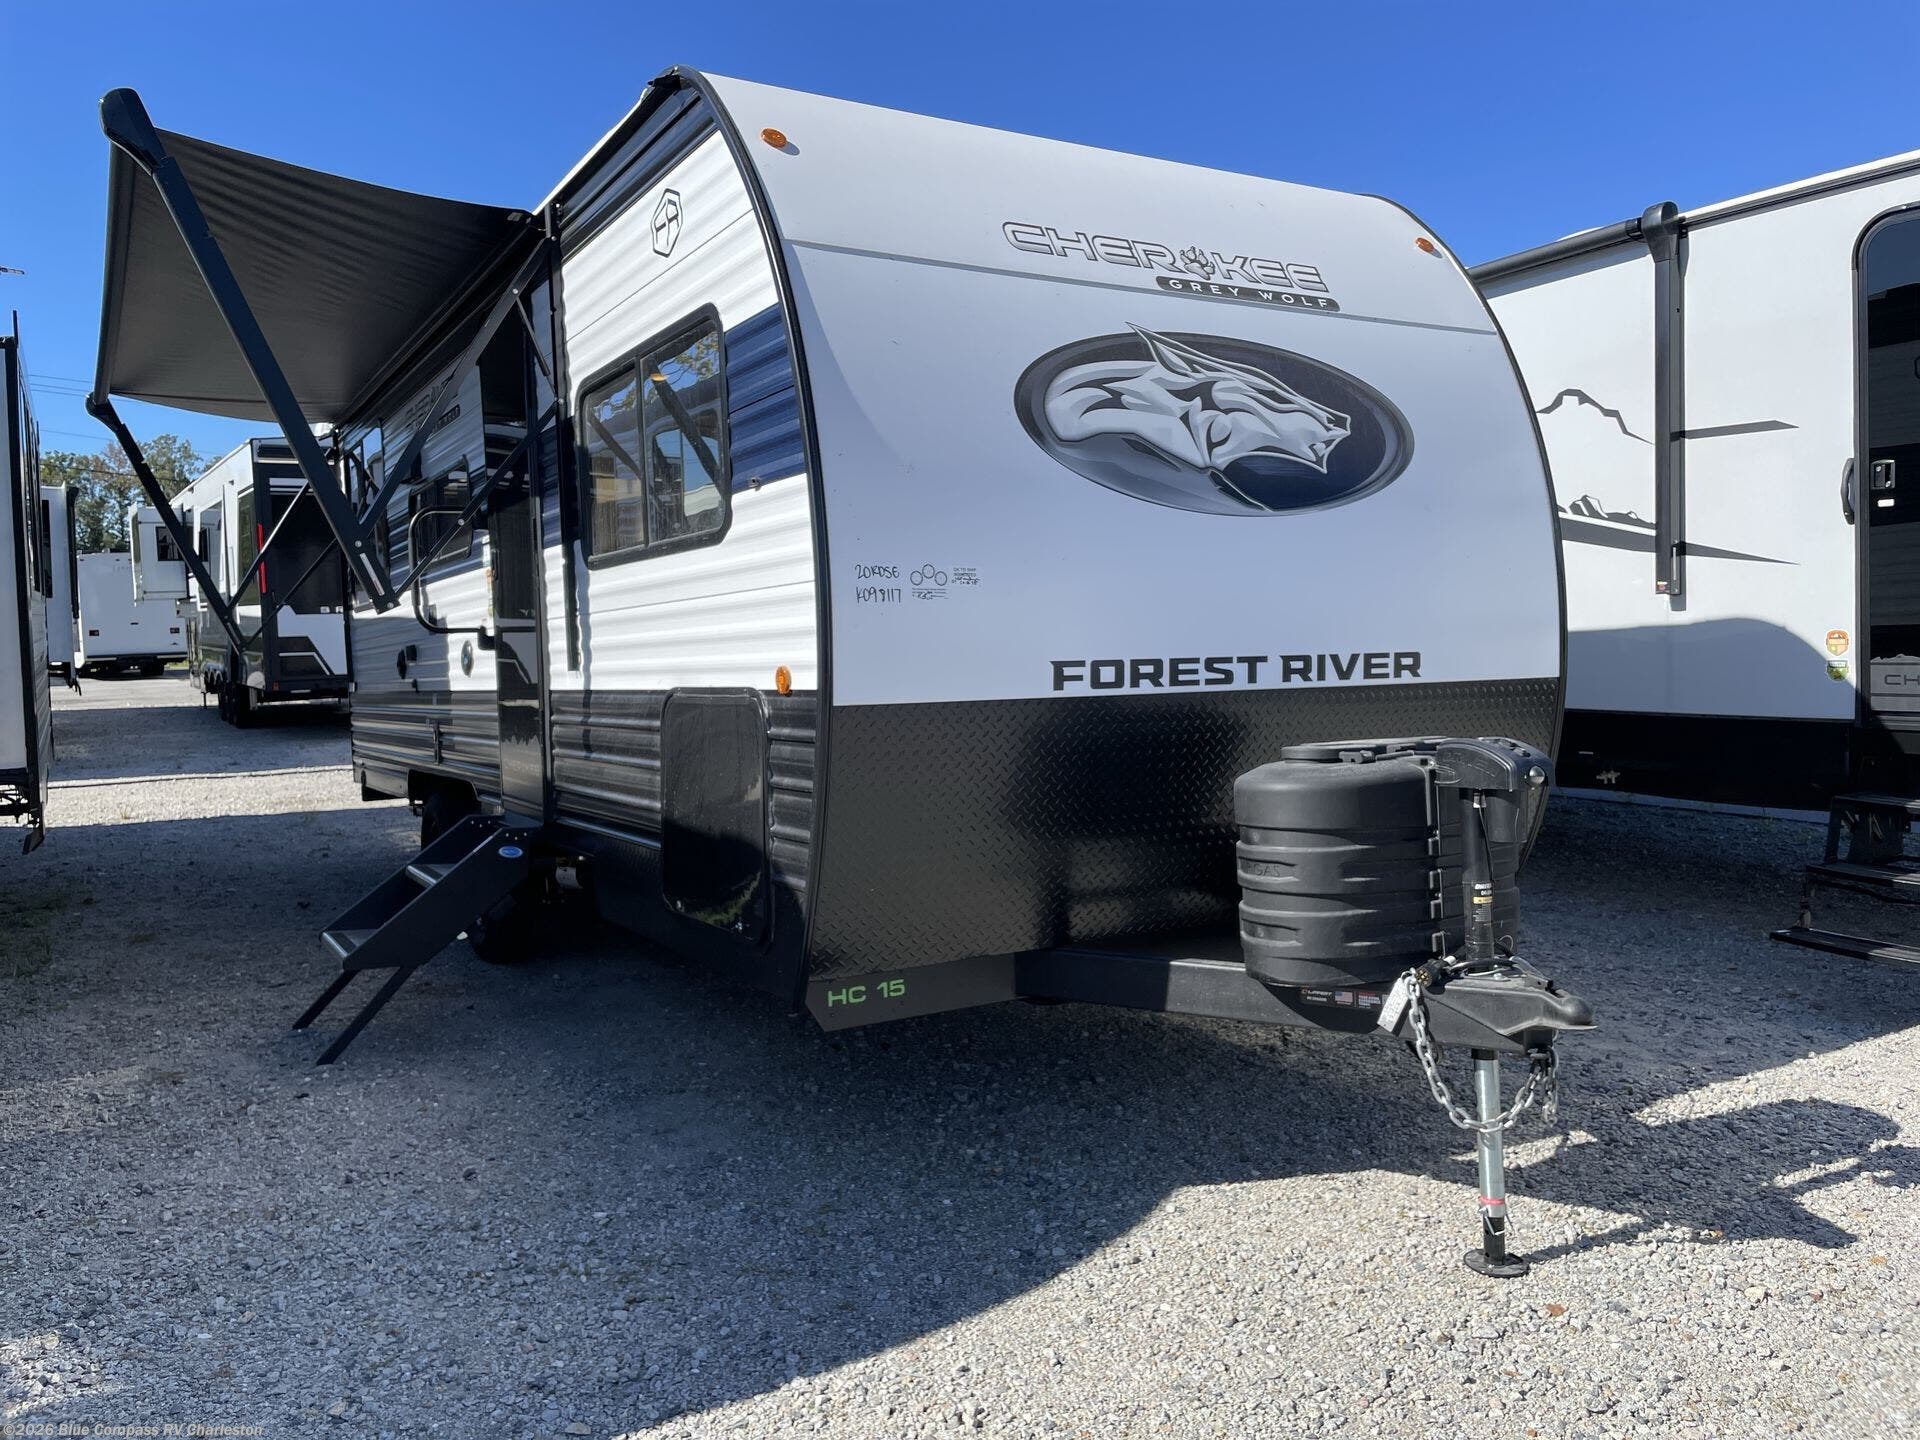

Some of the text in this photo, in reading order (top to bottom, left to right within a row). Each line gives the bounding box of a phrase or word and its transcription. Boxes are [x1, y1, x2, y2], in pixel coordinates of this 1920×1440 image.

[1168, 279, 1328, 309] GREY WOLF
[1050, 651, 1422, 691] FOREST RIVER
[827, 979, 906, 1007] HC 15
